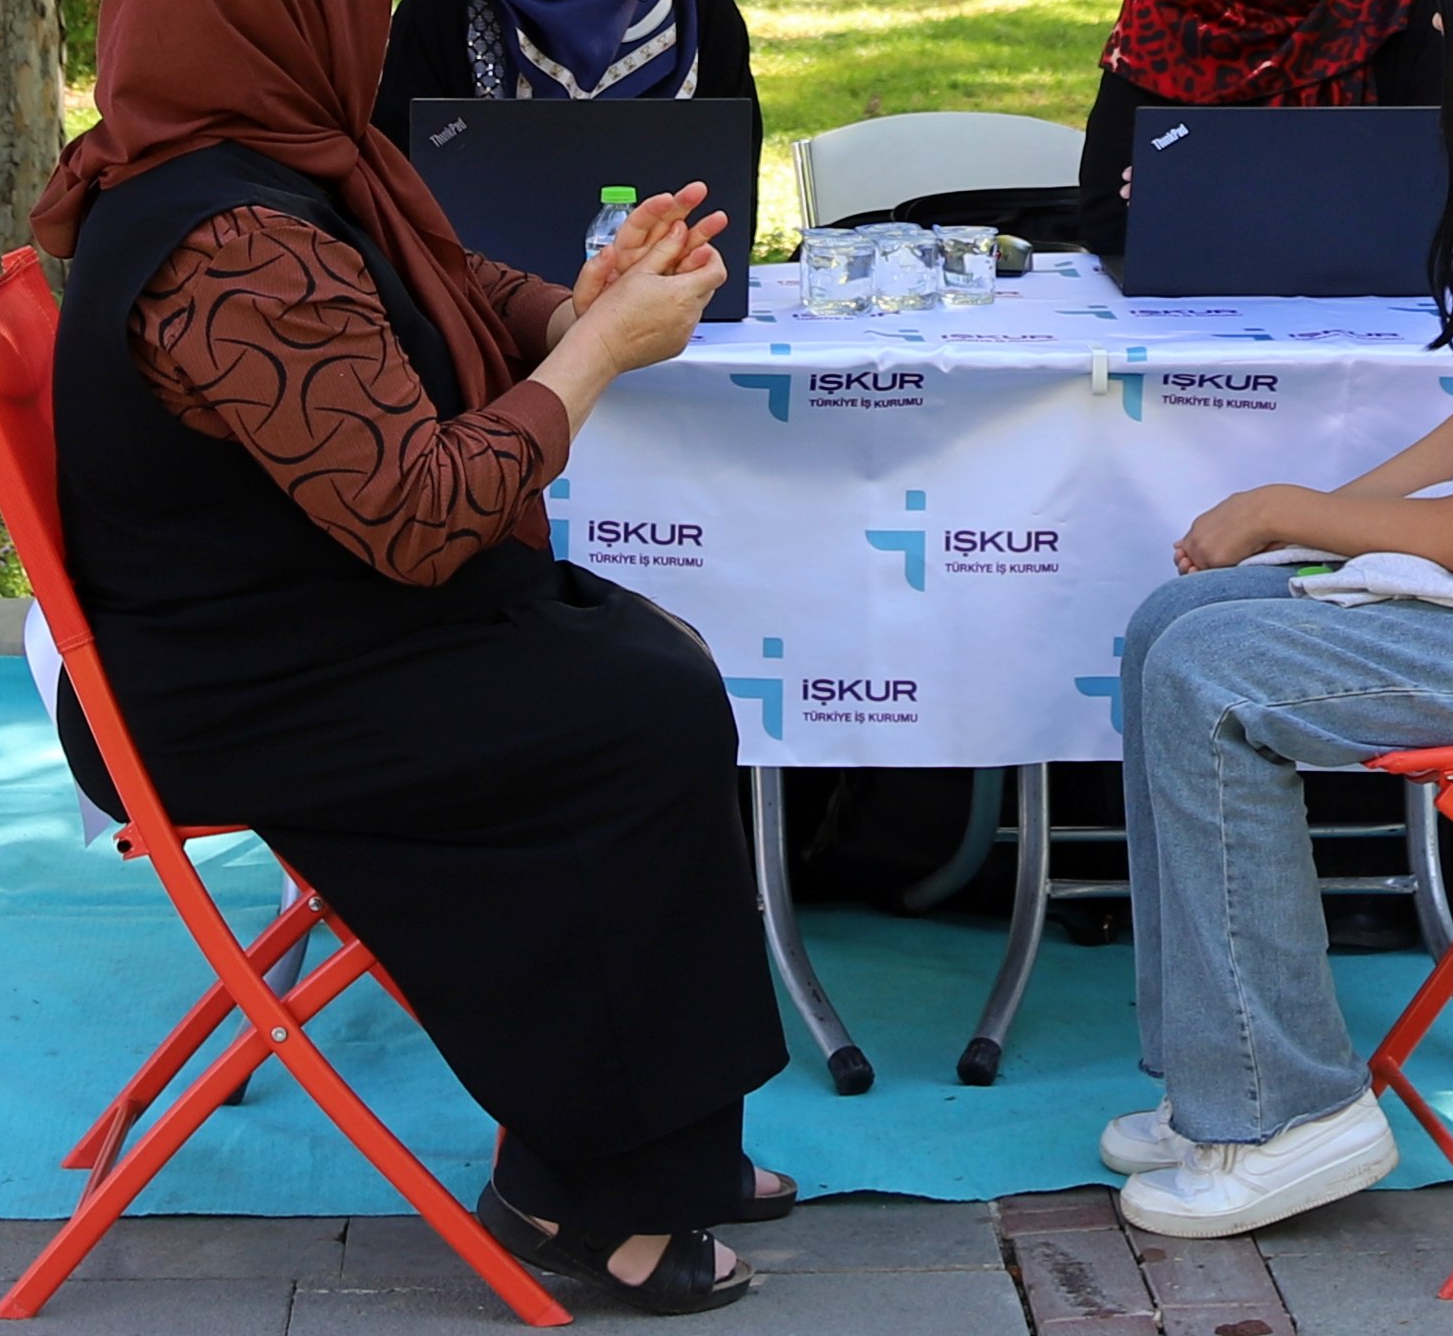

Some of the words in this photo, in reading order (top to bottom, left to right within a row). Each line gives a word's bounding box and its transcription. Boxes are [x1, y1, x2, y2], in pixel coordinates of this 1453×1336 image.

[428, 116, 468, 148] ThinkPad
[808, 397, 858, 408] TÜRKİYE
[860, 396, 872, 410] İŞ
[873, 397, 924, 409] KURUMU
[1162, 393, 1211, 407] TÜRKİYE
[1212, 396, 1224, 409] İŞ
[1226, 399, 1277, 411] KURUMU
[588, 551, 637, 565] TÜRKİYE
[639, 553, 651, 568] İŞ
[652, 556, 704, 568] KURUMU
[944, 561, 993, 574] TÜRKİYE
[995, 562, 1007, 576] İŞ
[1009, 563, 1060, 574] KURUMU
[802, 710, 852, 723] TÜRKİYE
[854, 710, 866, 725] İŞ
[867, 712, 919, 724] KURUMU
